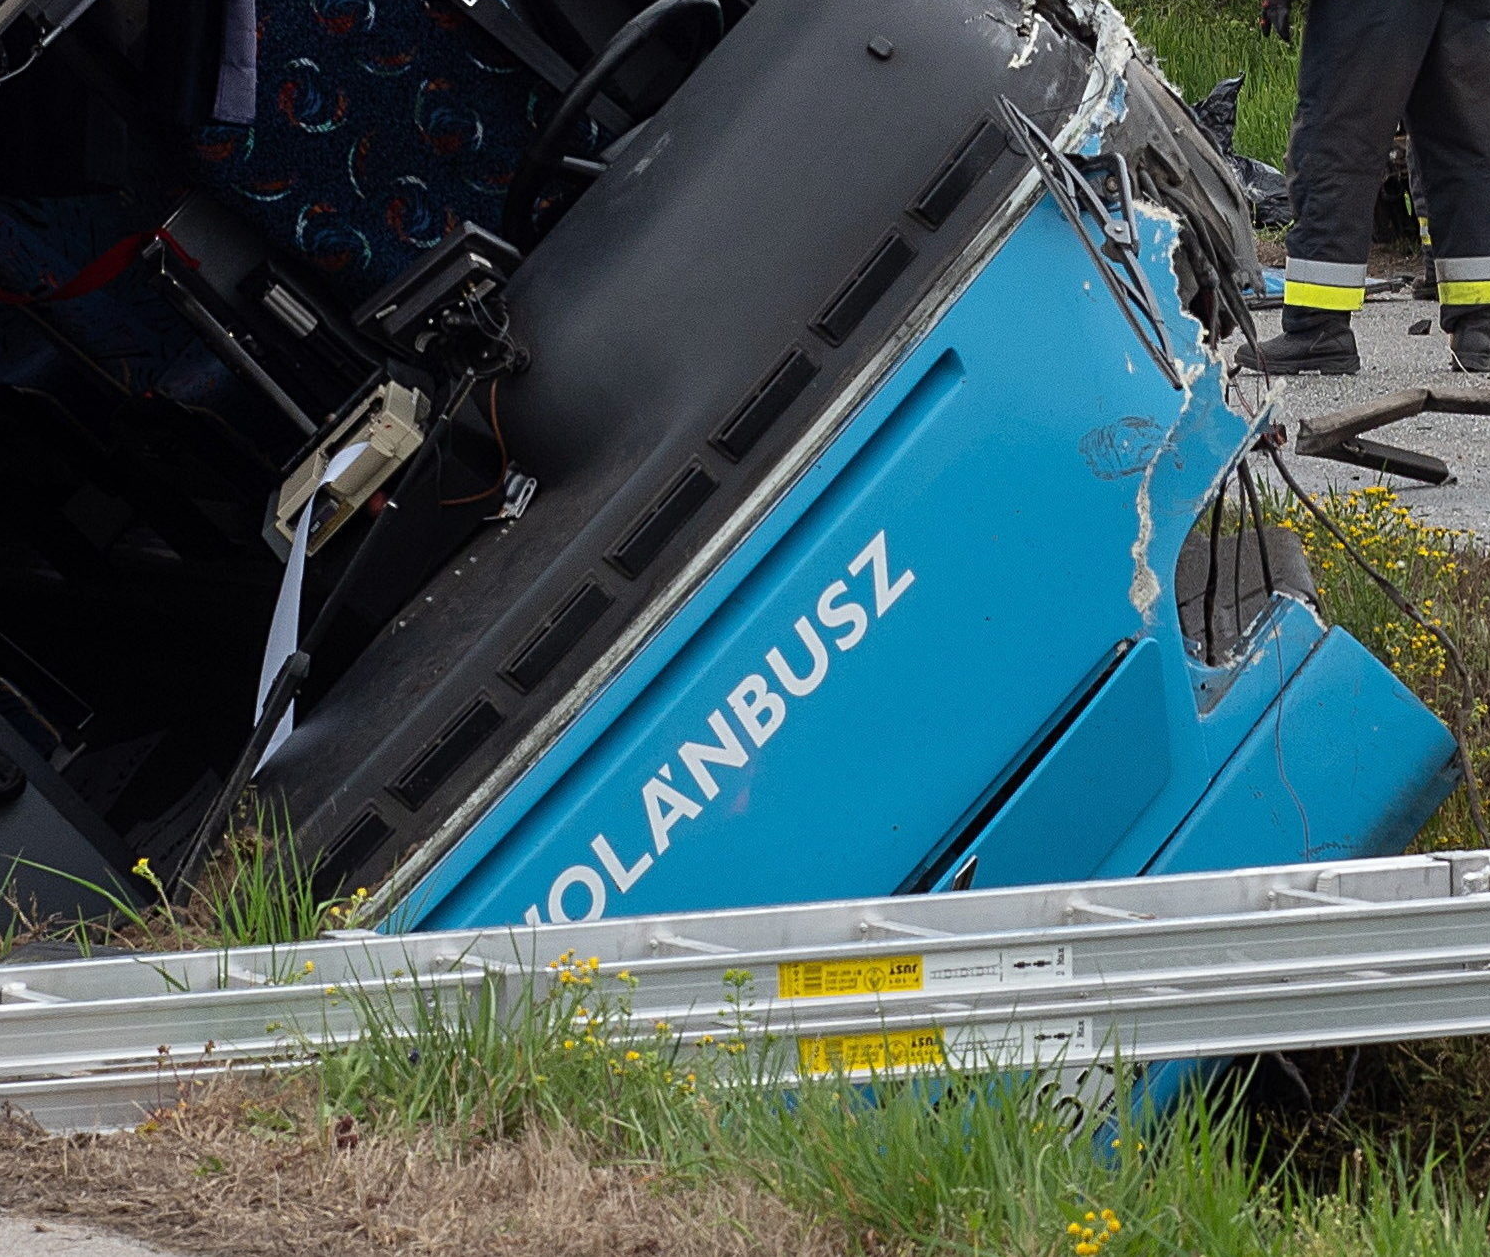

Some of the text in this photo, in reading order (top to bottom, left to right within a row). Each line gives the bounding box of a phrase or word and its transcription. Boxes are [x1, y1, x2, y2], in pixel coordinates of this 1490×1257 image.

[525, 529, 915, 925] OLÁNBUSZ
[889, 963, 919, 976] JUST
[911, 1035, 937, 1049] UST
